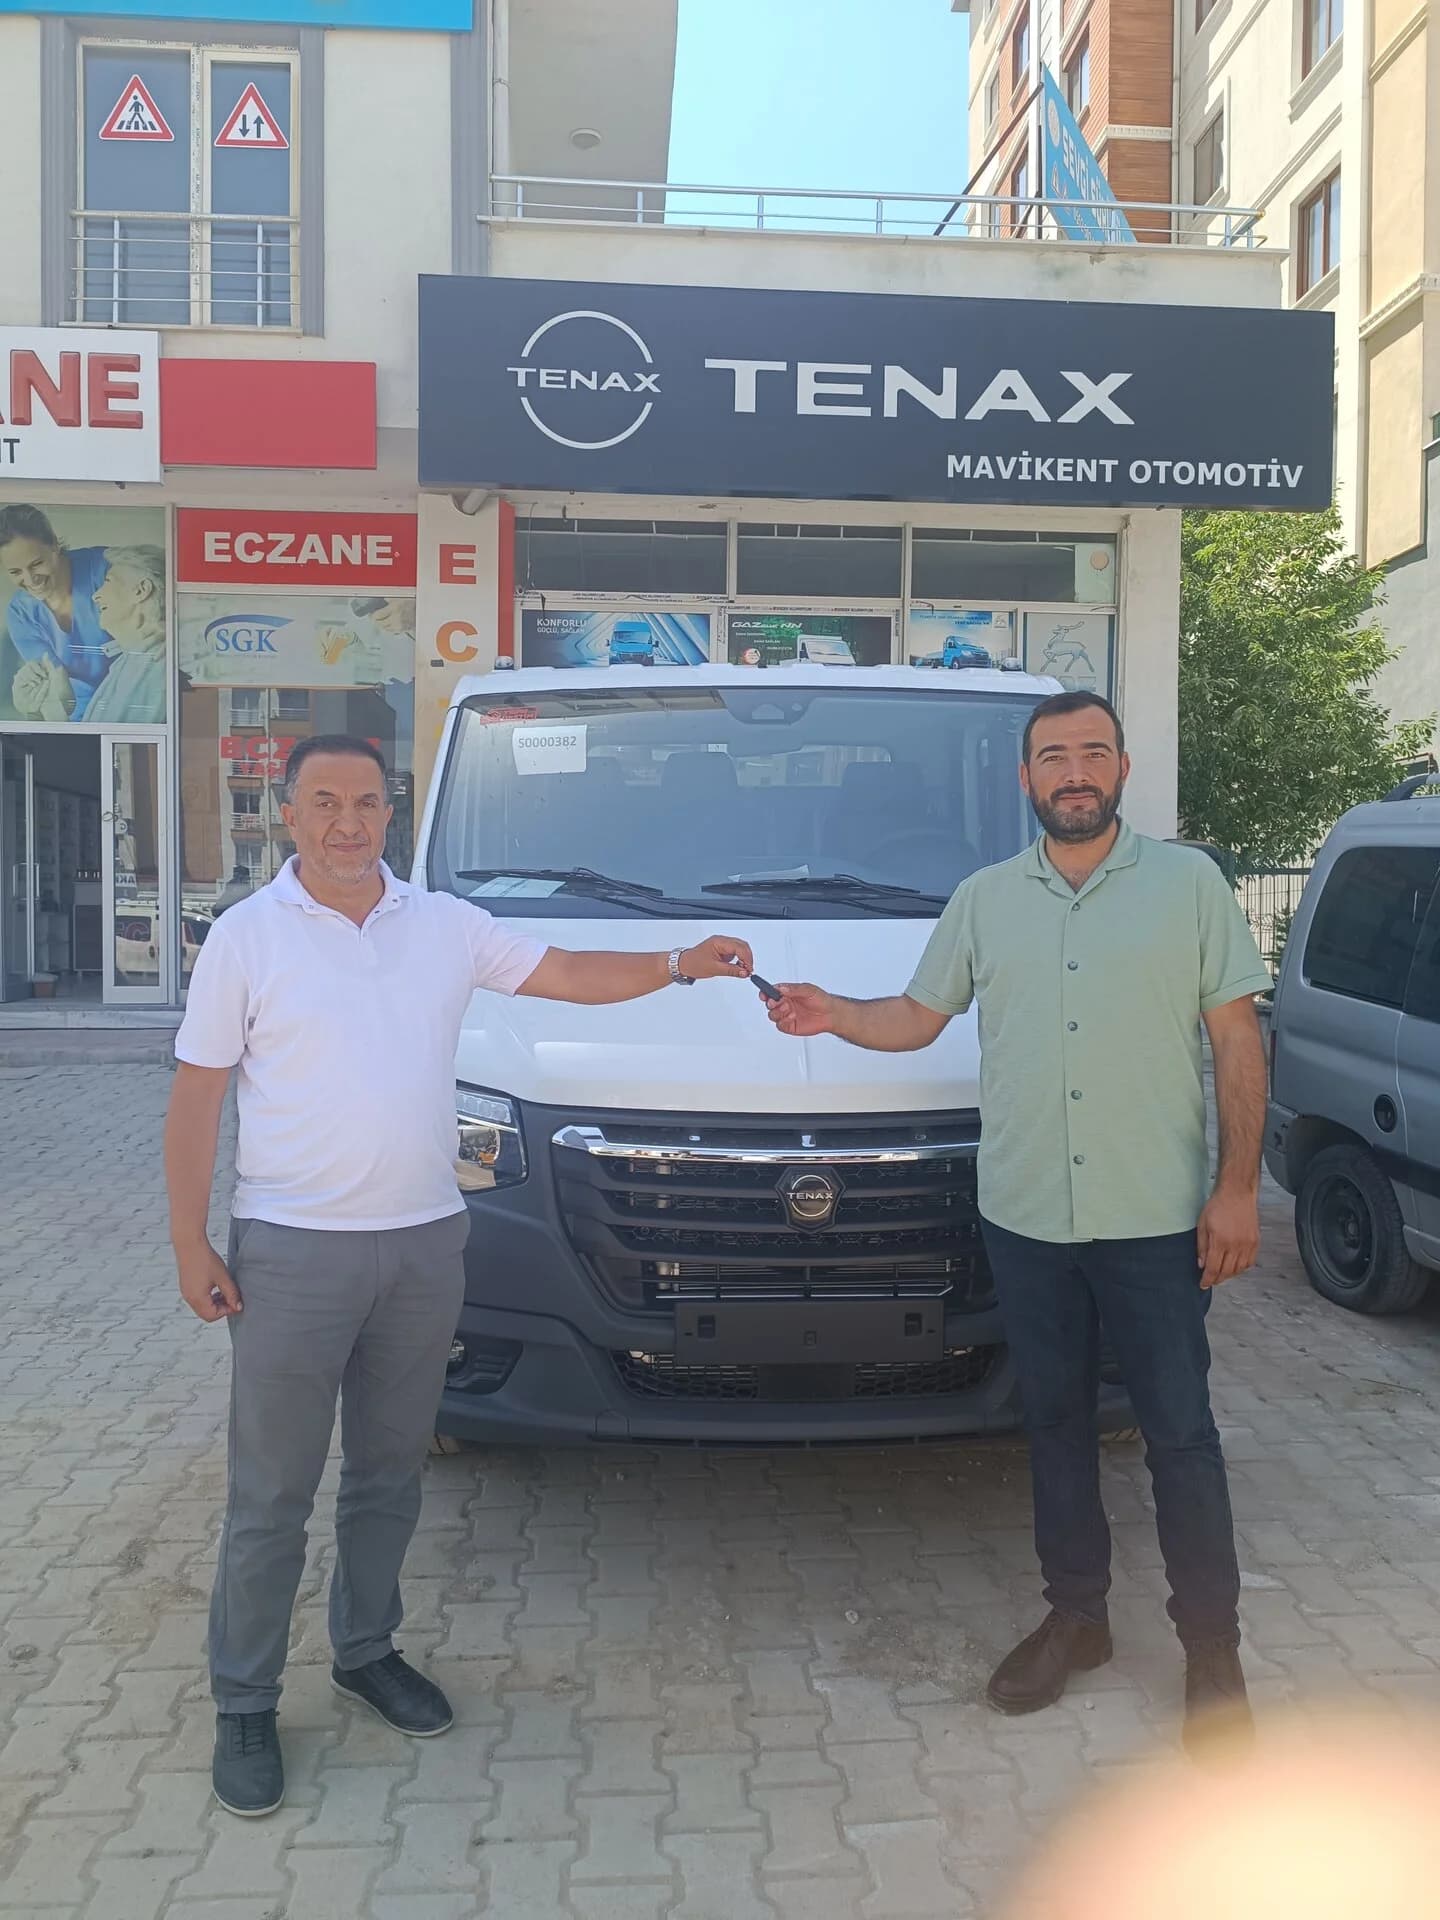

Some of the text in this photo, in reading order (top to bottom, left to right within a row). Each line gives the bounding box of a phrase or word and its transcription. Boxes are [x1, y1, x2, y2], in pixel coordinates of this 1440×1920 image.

[0, 350, 143, 429] NE
[507, 367, 661, 393] TENAX
[705, 359, 1135, 426] TENAX
[0, 438, 20, 464] T
[947, 450, 1304, 489] MAVİKENT OTOMOTİV
[204, 531, 393, 565] ECZANE
[215, 629, 279, 653] SGK
[787, 1192, 833, 1200] TENAX
